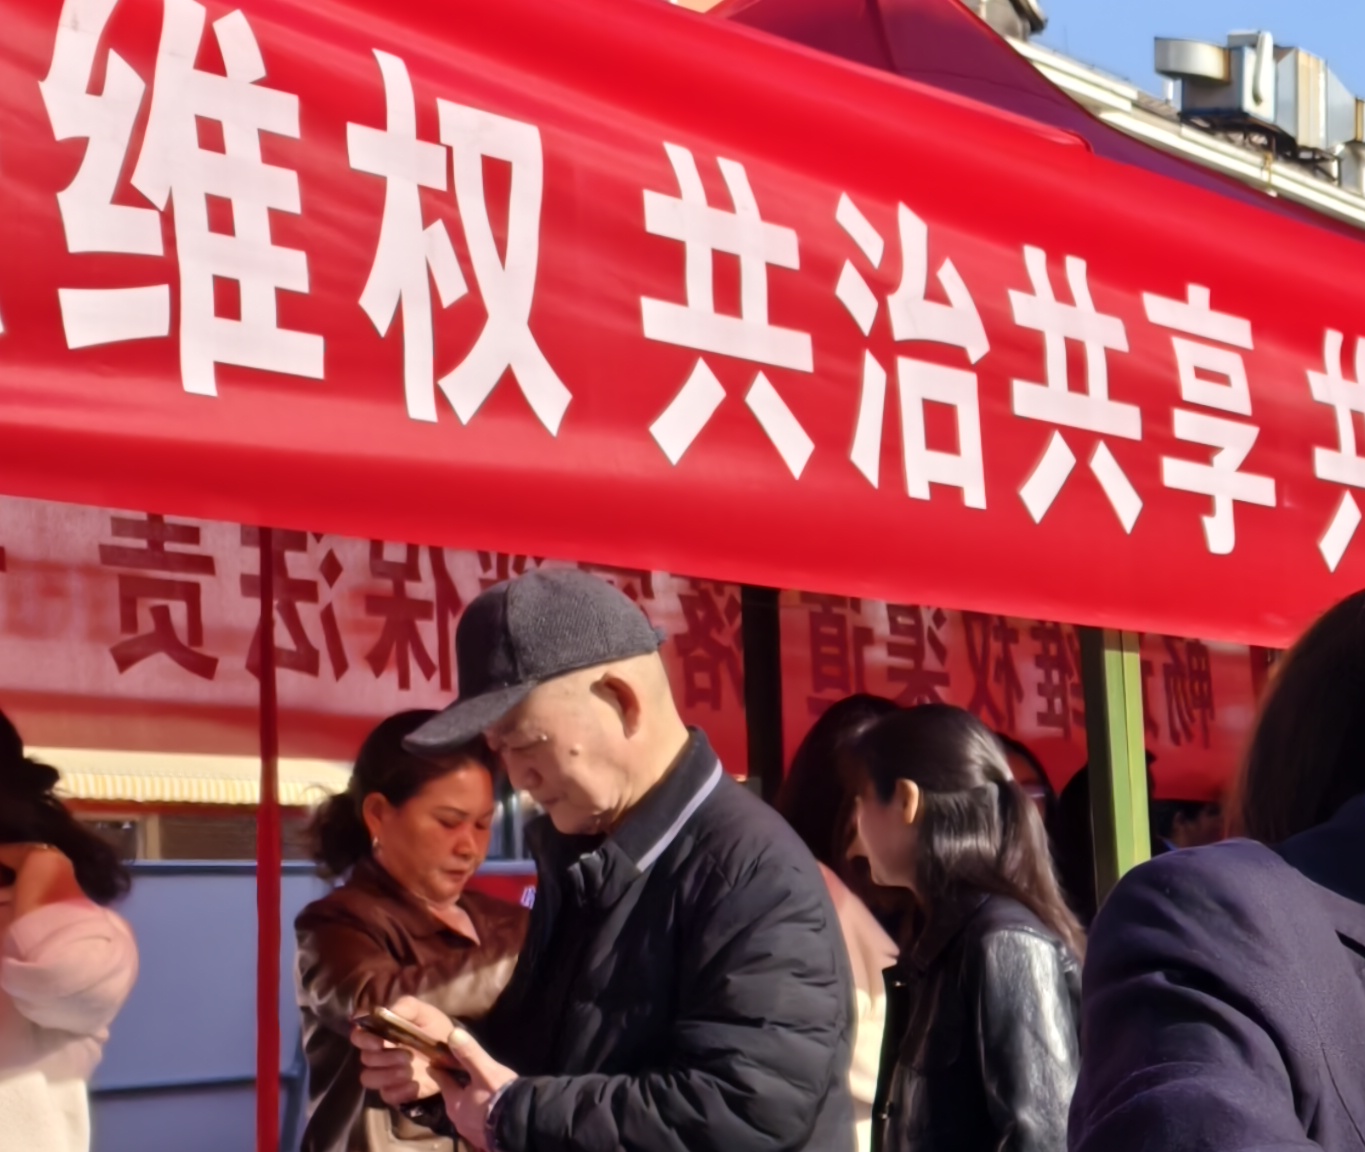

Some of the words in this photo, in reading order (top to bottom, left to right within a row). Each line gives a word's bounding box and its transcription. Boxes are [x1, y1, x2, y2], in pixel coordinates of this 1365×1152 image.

[0, 0, 573, 437] 维权
[640, 142, 1277, 556] 共治共享
